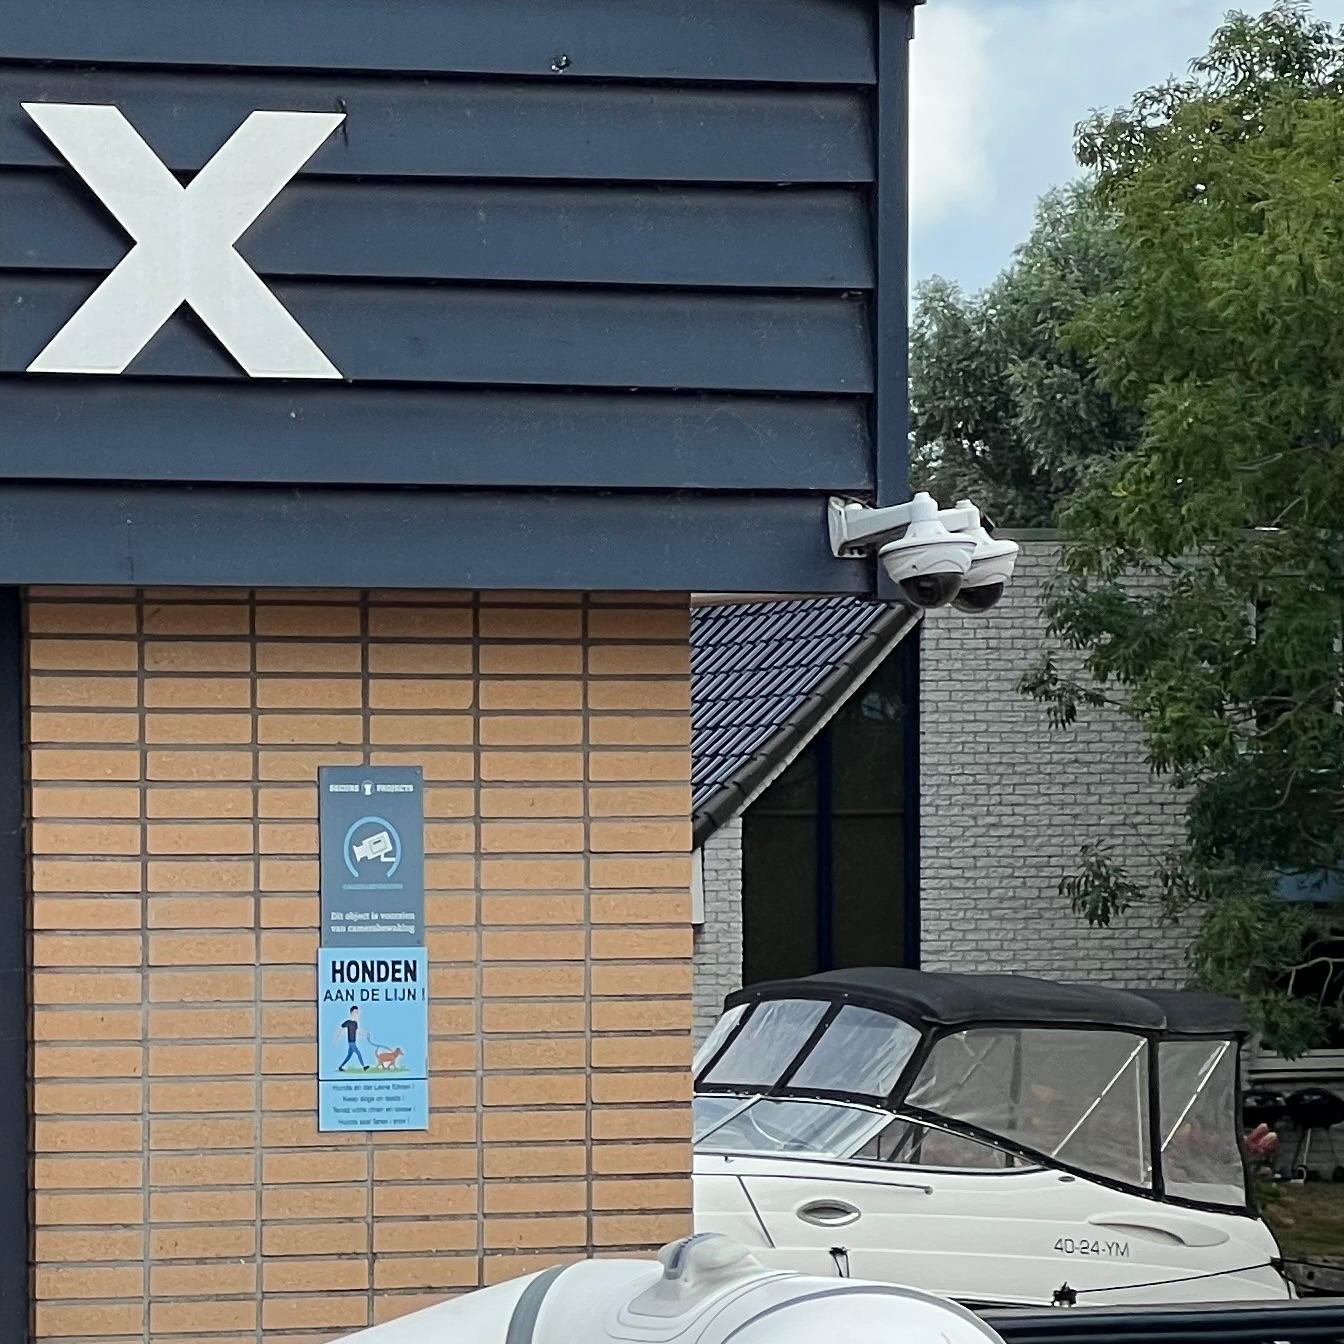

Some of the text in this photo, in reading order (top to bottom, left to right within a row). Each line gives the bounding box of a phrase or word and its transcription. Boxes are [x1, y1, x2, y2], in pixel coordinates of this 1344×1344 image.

[332, 960, 417, 983] HONDEN
[323, 989, 354, 1001] AAN
[360, 989, 380, 1001] DE
[385, 988, 416, 1001] LIJN
